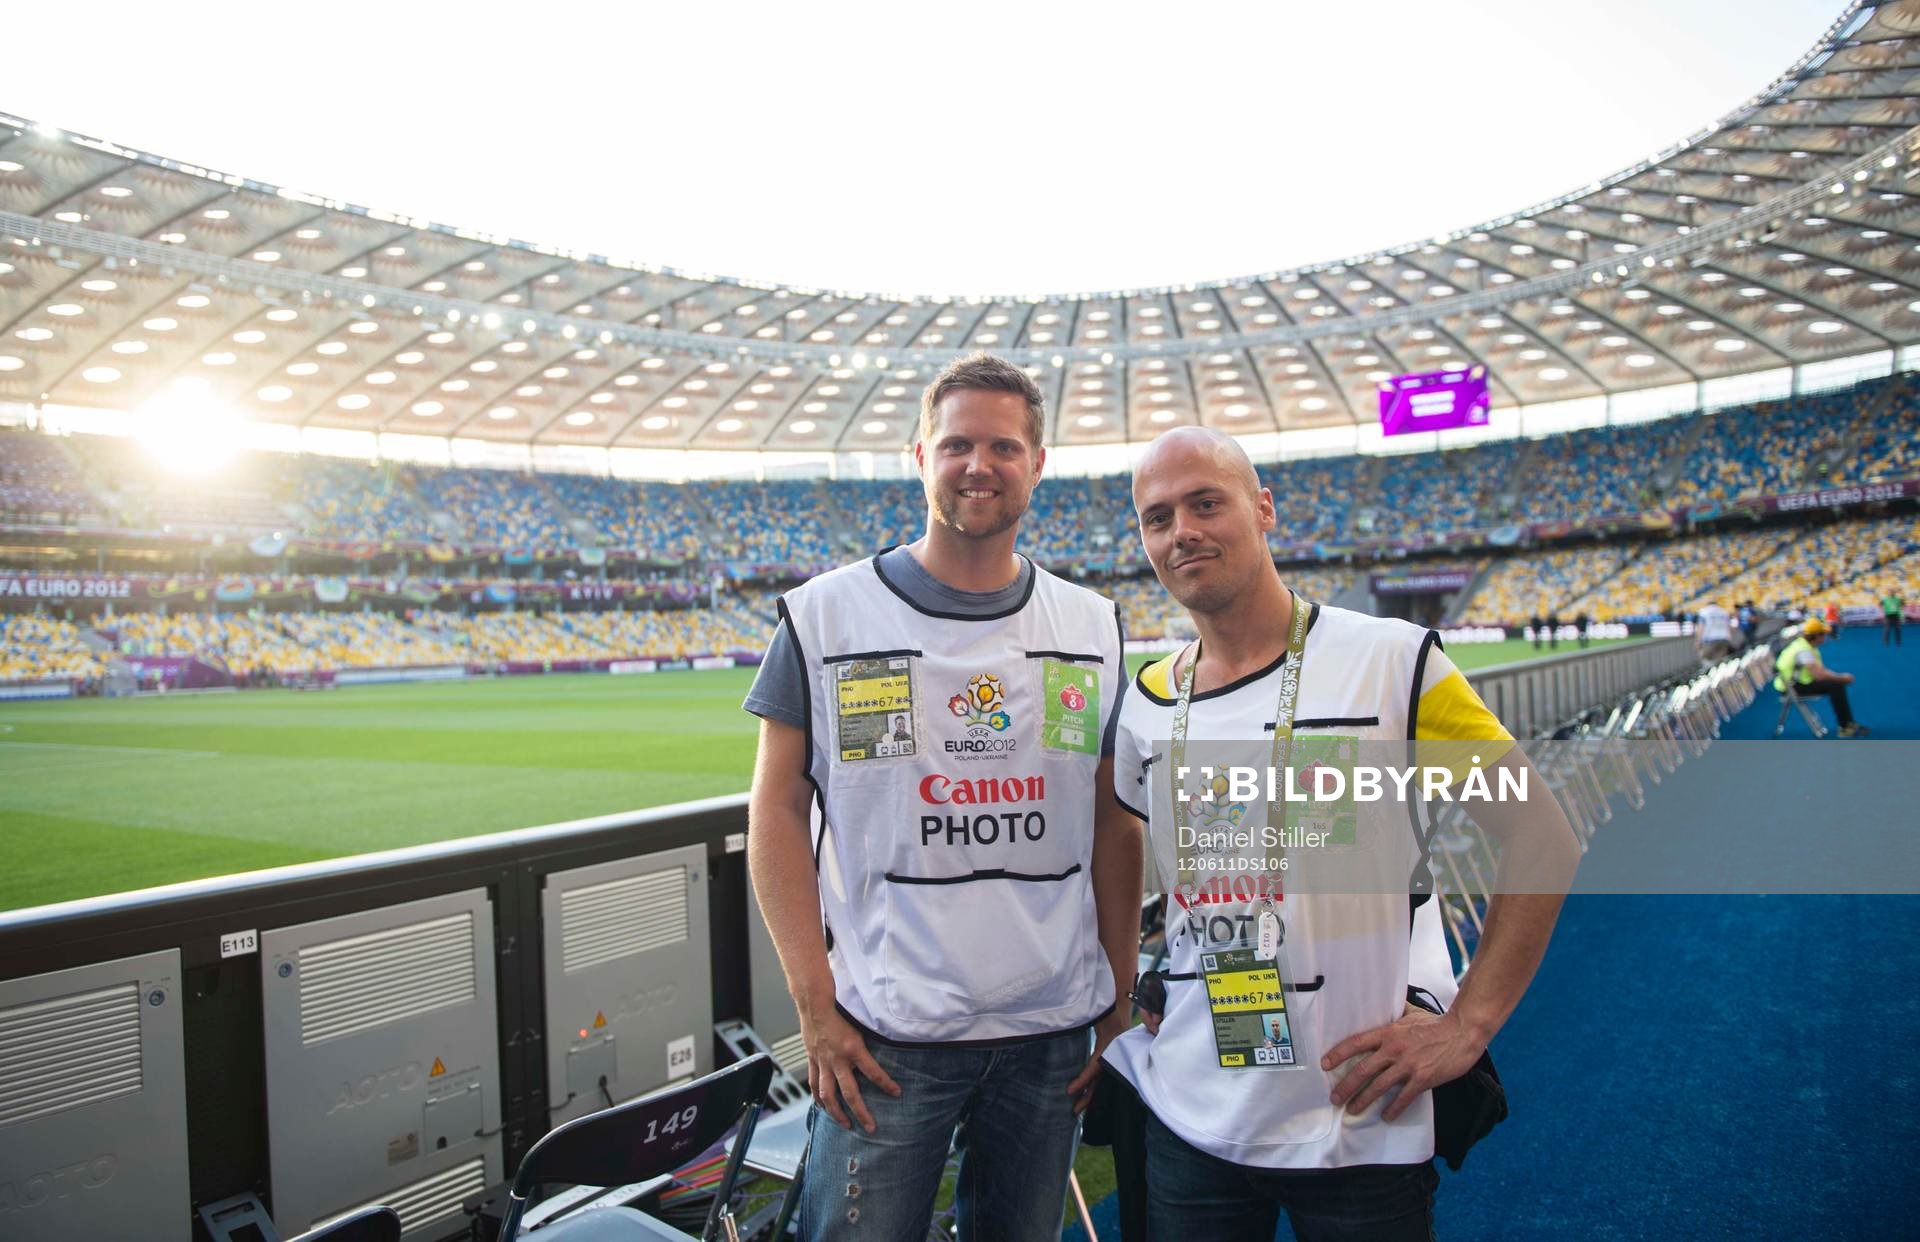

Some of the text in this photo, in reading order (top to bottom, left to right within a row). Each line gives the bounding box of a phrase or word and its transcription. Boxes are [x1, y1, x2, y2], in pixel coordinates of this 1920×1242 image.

[1777, 483, 1905, 511] UEFA EURO 2012
[26, 579, 80, 597] EURO
[83, 579, 130, 598] 2012
[969, 729, 989, 738] UEFA
[919, 774, 1046, 805] Canon
[921, 811, 1046, 846] PHOTO
[222, 936, 254, 952] E113
[643, 1105, 698, 1144] 149
